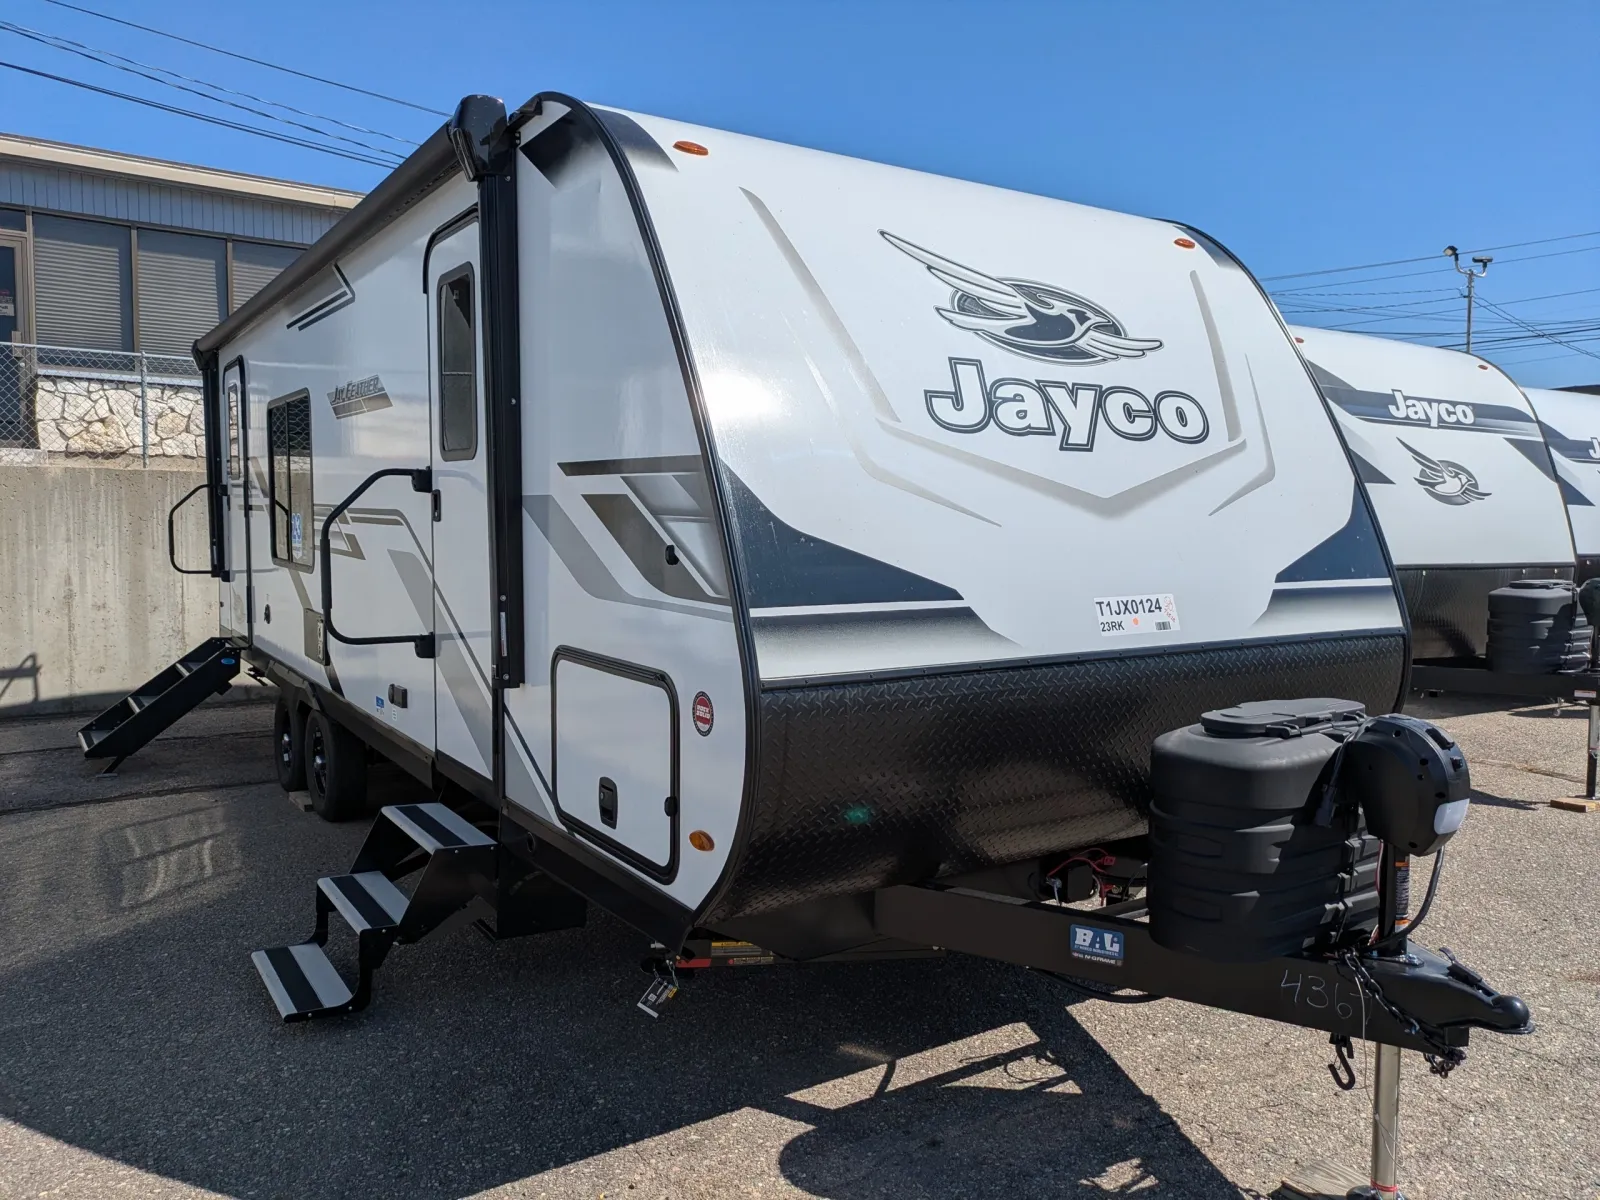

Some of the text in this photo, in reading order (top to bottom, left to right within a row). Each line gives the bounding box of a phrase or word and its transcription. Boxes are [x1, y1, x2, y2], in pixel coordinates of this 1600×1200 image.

[346, 374, 380, 400] FEATHER
[924, 357, 1210, 452] Jayco
[1388, 389, 1474, 428] Jayco
[1095, 597, 1163, 617] T1JX0124
[1100, 620, 1125, 632] 23RK
[696, 704, 710, 714] ROCK
[696, 710, 711, 720] SOLID
[1075, 928, 1120, 953] BAL
[1281, 969, 1373, 1026] 4367
